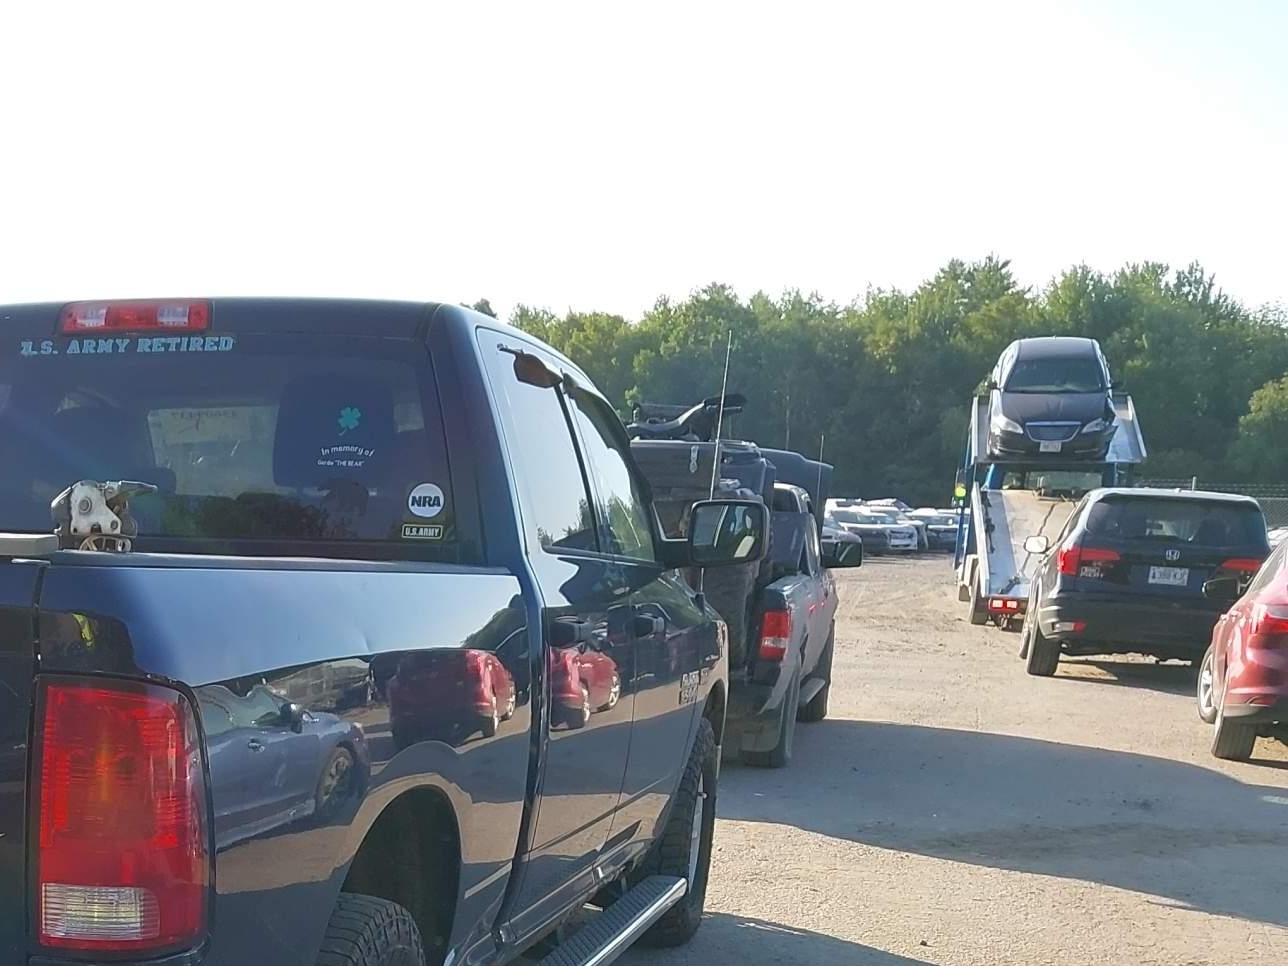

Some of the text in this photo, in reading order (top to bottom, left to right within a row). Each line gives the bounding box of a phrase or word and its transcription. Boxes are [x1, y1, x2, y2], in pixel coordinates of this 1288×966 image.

[66, 338, 130, 354] ARMY
[136, 336, 235, 353] RETIRED
[410, 495, 441, 508] NRA
